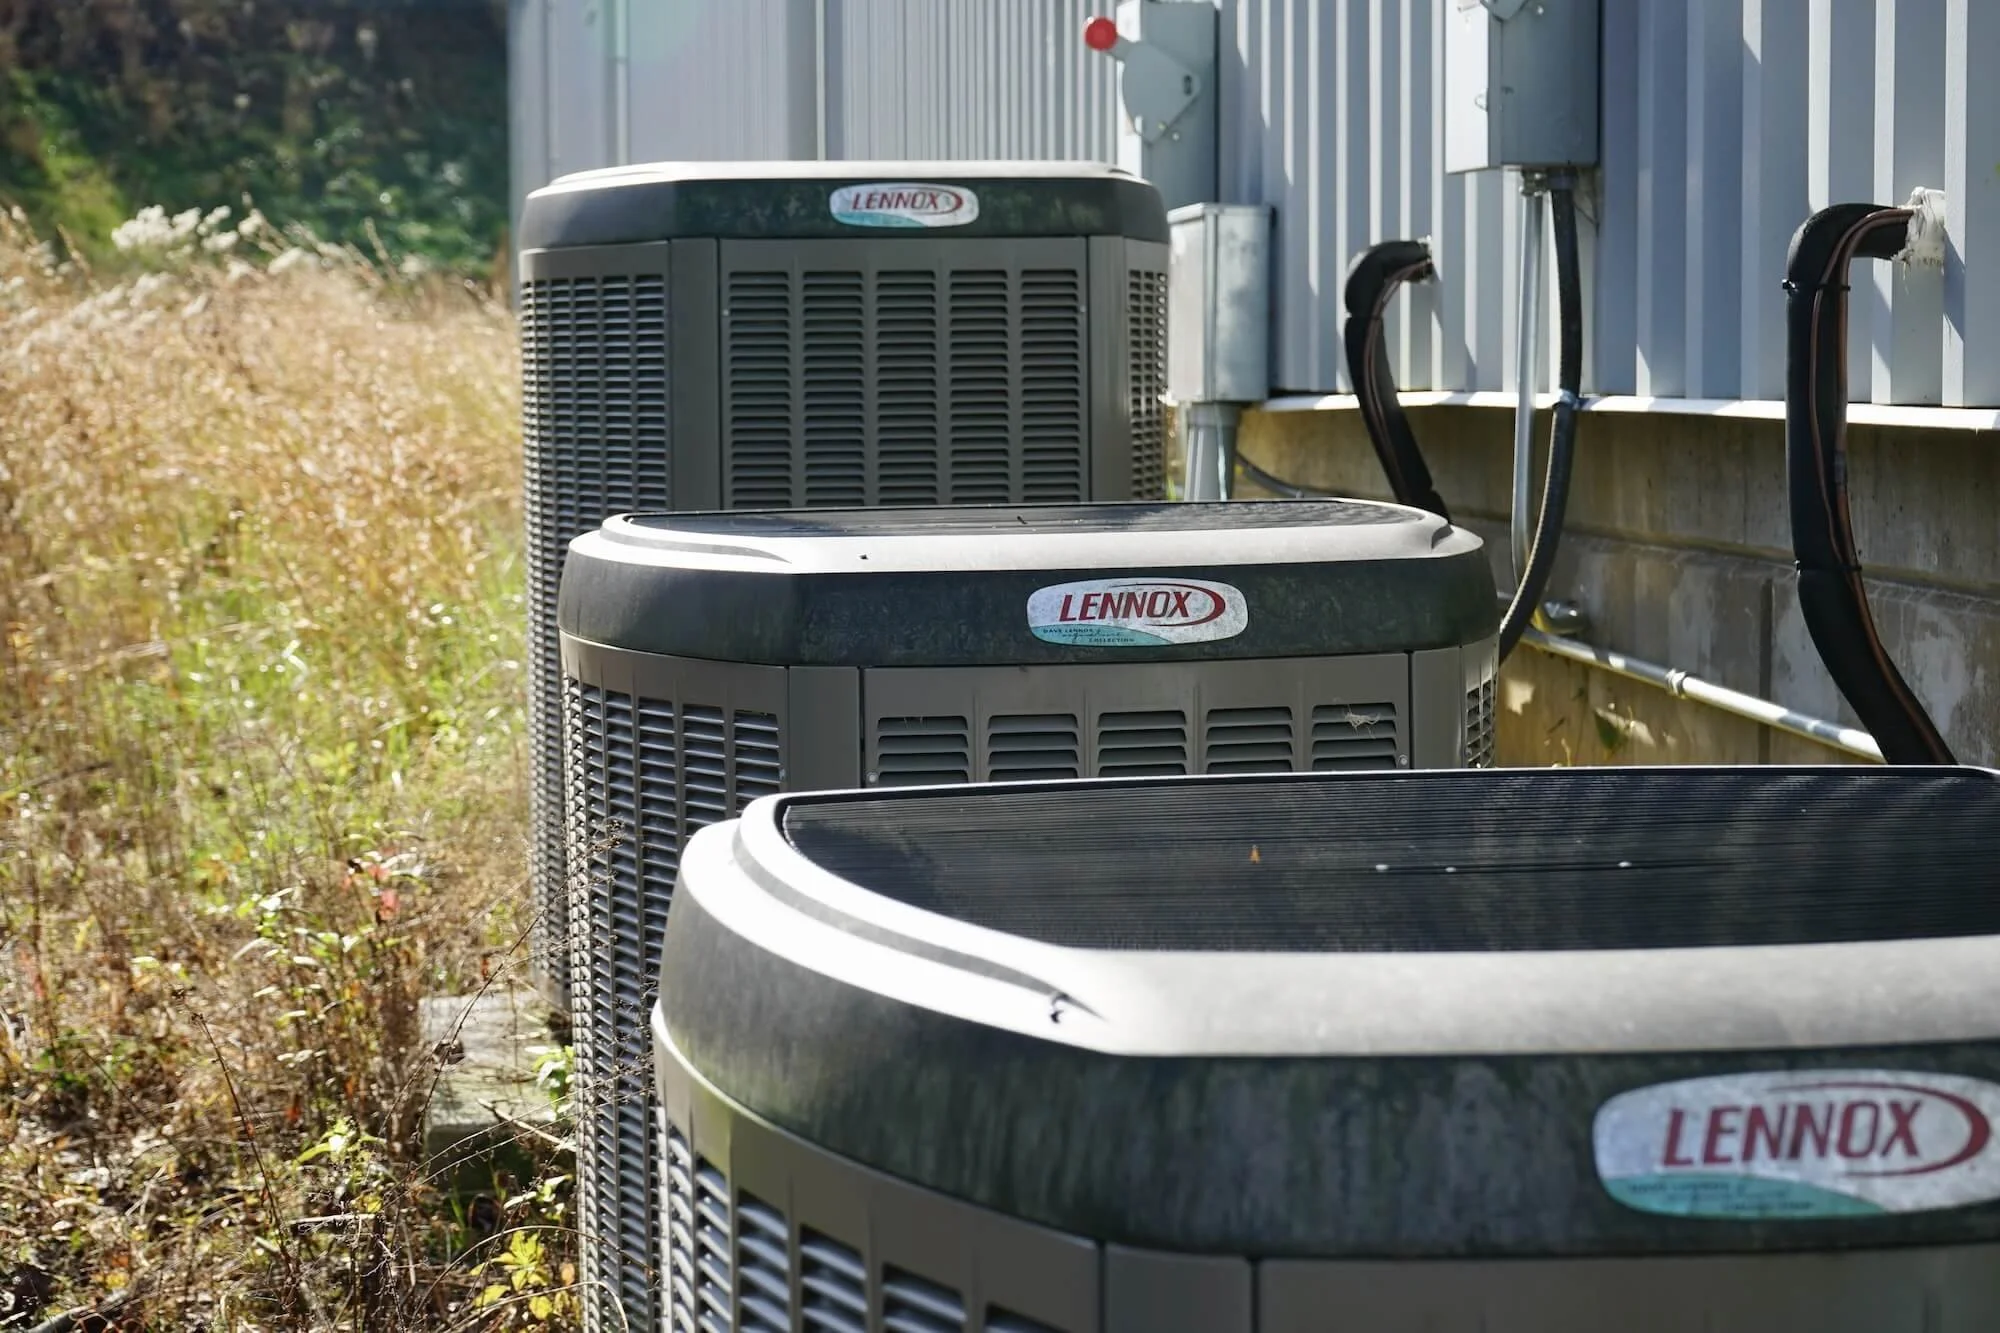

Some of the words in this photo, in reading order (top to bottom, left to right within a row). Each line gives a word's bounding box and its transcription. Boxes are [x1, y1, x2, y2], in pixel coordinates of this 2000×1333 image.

[852, 192, 940, 210] LENNOX
[1059, 591, 1192, 622] LENNOX
[1660, 1100, 1922, 1167] LENNOX
